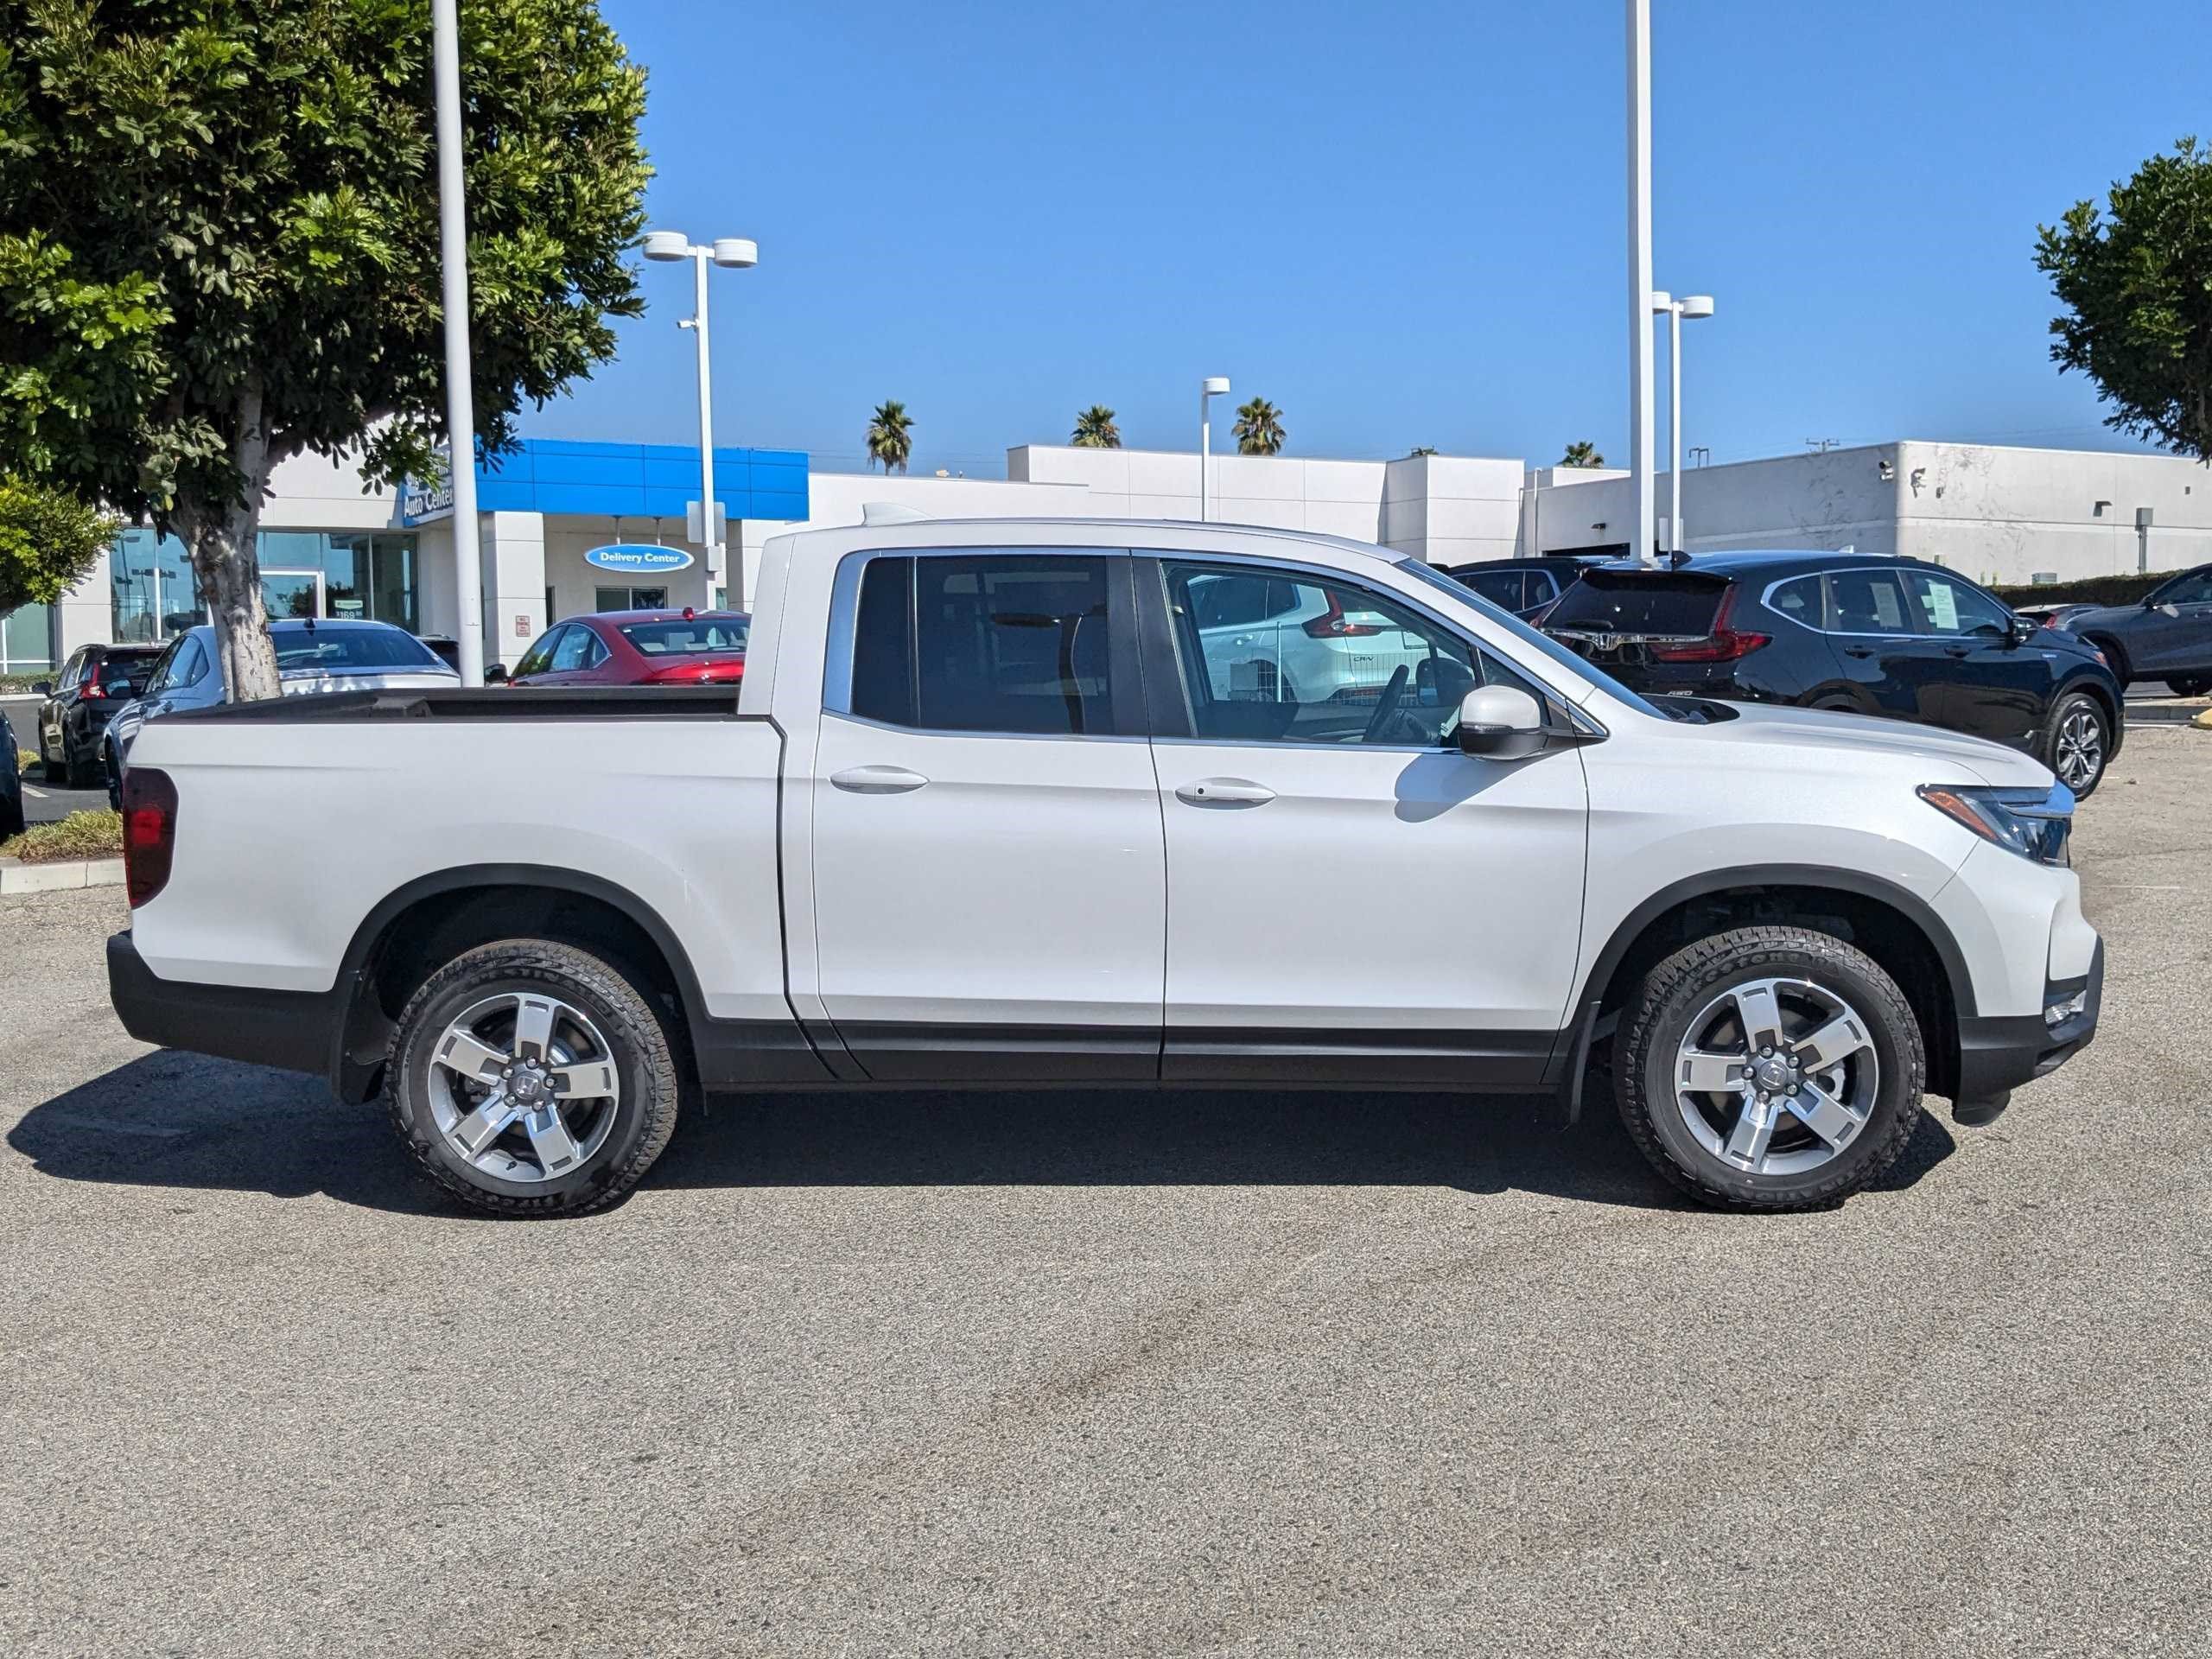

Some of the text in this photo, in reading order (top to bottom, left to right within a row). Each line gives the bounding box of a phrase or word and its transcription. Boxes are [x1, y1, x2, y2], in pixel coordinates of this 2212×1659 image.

[404, 496, 423, 518] Auto
[601, 552, 680, 563] Delivery Center
